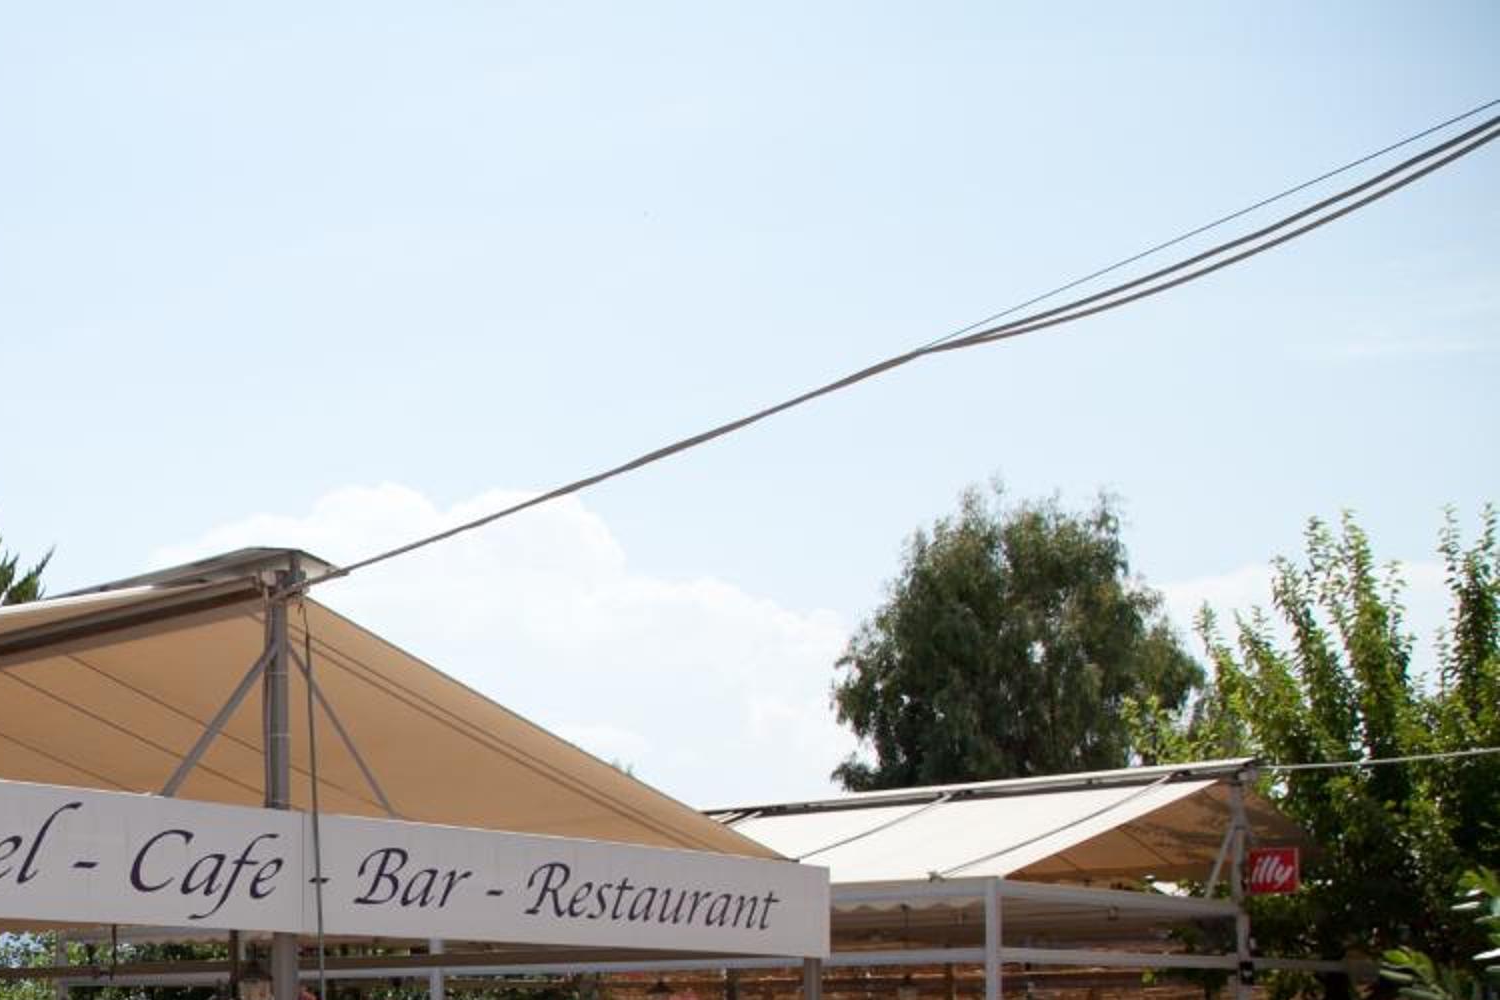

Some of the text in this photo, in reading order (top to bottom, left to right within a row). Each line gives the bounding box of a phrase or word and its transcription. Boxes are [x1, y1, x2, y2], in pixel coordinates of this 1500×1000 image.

[129, 829, 284, 920] Cafe
[352, 848, 472, 908] Bar
[525, 862, 780, 930] Restaurant
[1251, 855, 1294, 889] illy
